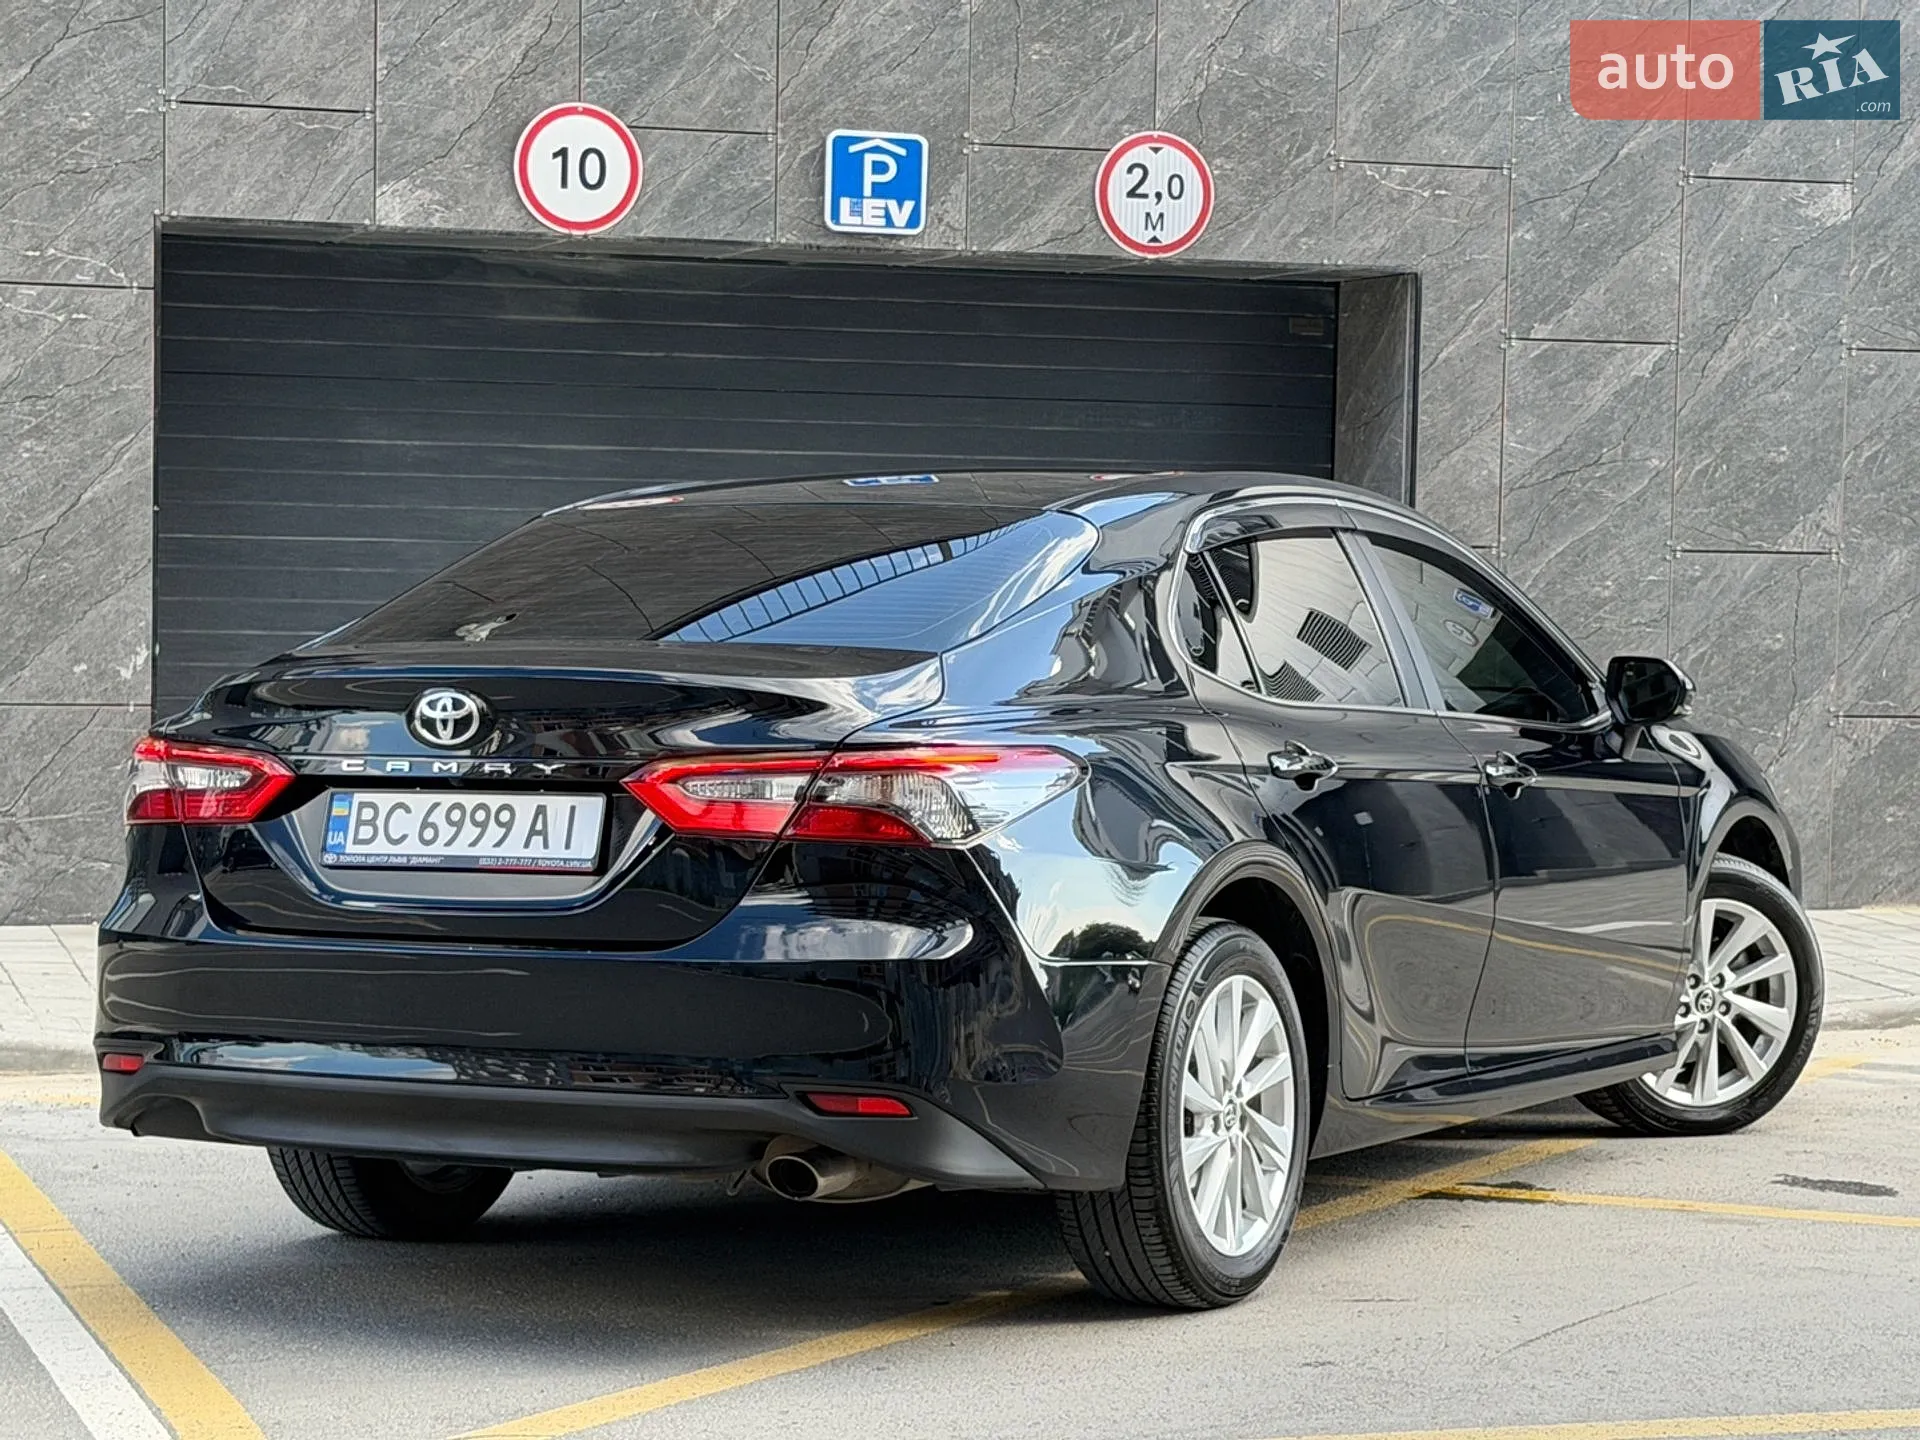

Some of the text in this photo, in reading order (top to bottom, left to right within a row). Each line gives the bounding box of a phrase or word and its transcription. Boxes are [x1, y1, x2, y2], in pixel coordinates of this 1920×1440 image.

[552, 146, 607, 191] 10
[863, 152, 898, 197] P
[1126, 162, 1185, 206] 2,0
[839, 197, 916, 227] LEV
[341, 759, 566, 775] CAMRY
[327, 831, 345, 845] UA
